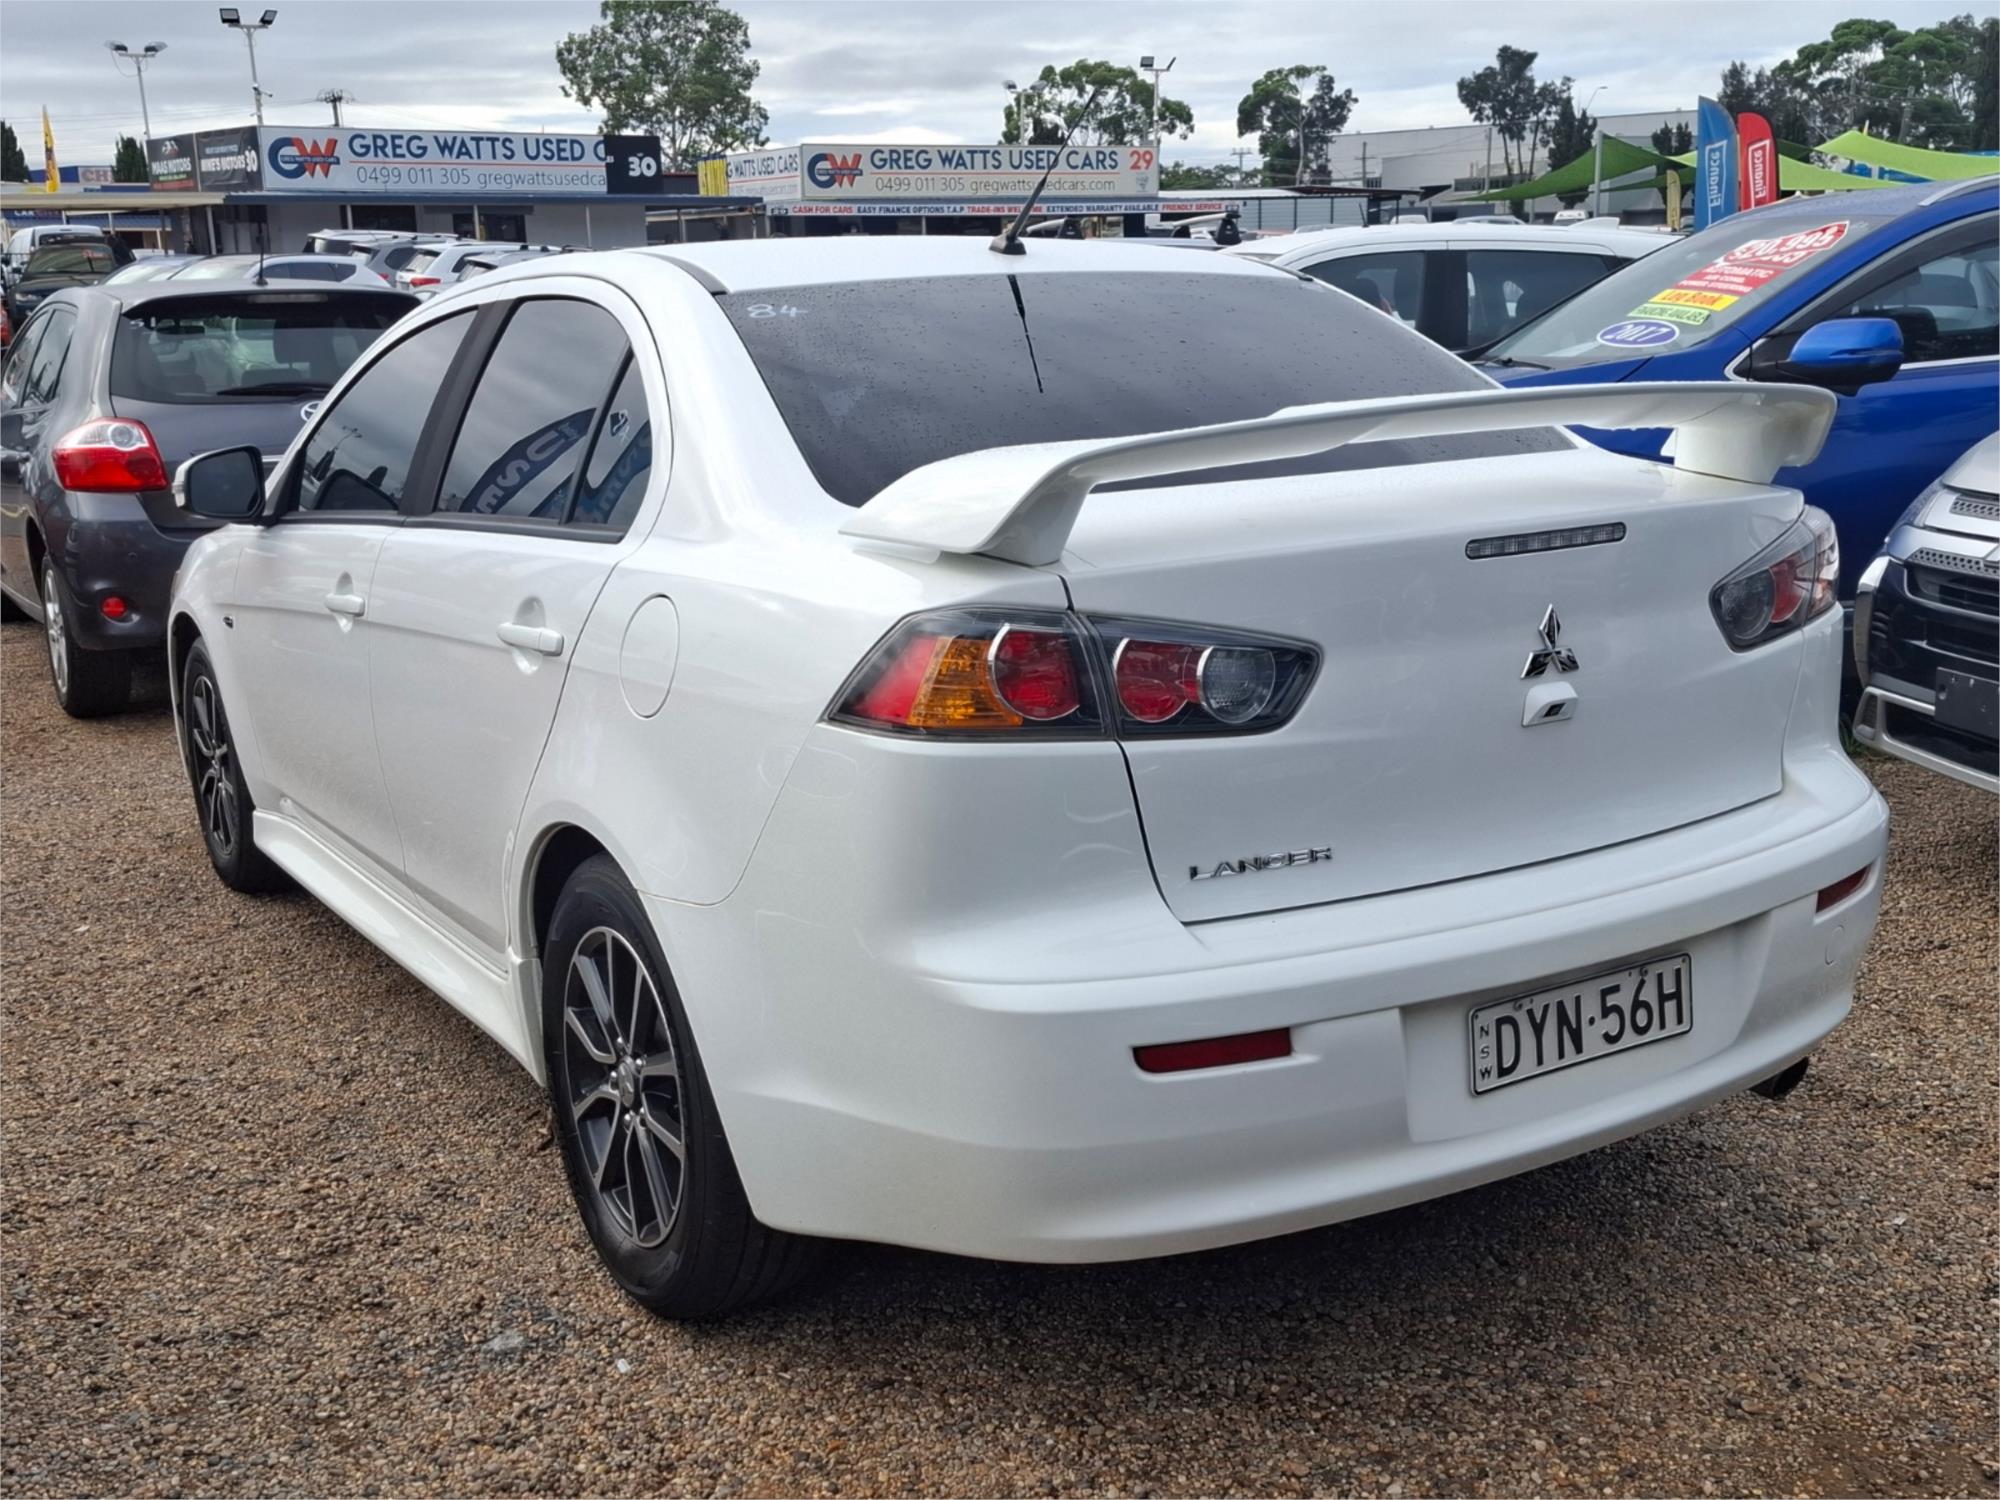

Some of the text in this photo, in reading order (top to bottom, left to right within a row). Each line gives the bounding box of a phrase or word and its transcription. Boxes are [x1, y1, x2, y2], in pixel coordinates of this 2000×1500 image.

[348, 134, 428, 159] GREG
[433, 135, 515, 160] WATTS
[523, 138, 585, 162] USED
[168, 157, 191, 173] MOTORS
[628, 156, 657, 177] 30
[733, 159, 756, 178] WATTS
[757, 156, 776, 176] USED
[777, 154, 799, 174] CARS
[870, 150, 1119, 170] GREG WATTS USED CARS
[1129, 150, 1153, 170] 29
[357, 166, 606, 189] 0499 011 305 gregwattsusedca
[875, 176, 1115, 194] 0499 011 305 gregwattsedcars.com
[792, 205, 813, 214] CASH
[815, 205, 831, 214] FOR
[832, 205, 853, 214] CARS
[857, 205, 876, 214] EASY
[879, 205, 911, 214] FINANCE
[912, 205, 944, 214] OPTIONS
[967, 205, 1006, 214] TRADE-INS
[1046, 205, 1085, 213] EXTENDED
[1086, 204, 1122, 213] WARRANTY
[1123, 204, 1159, 212] AVAILABLE
[1161, 203, 1194, 211] FRIENDLY
[746, 302, 809, 319] 84
[1602, 324, 1672, 342] 2017
[1189, 847, 1332, 881] LANCER
